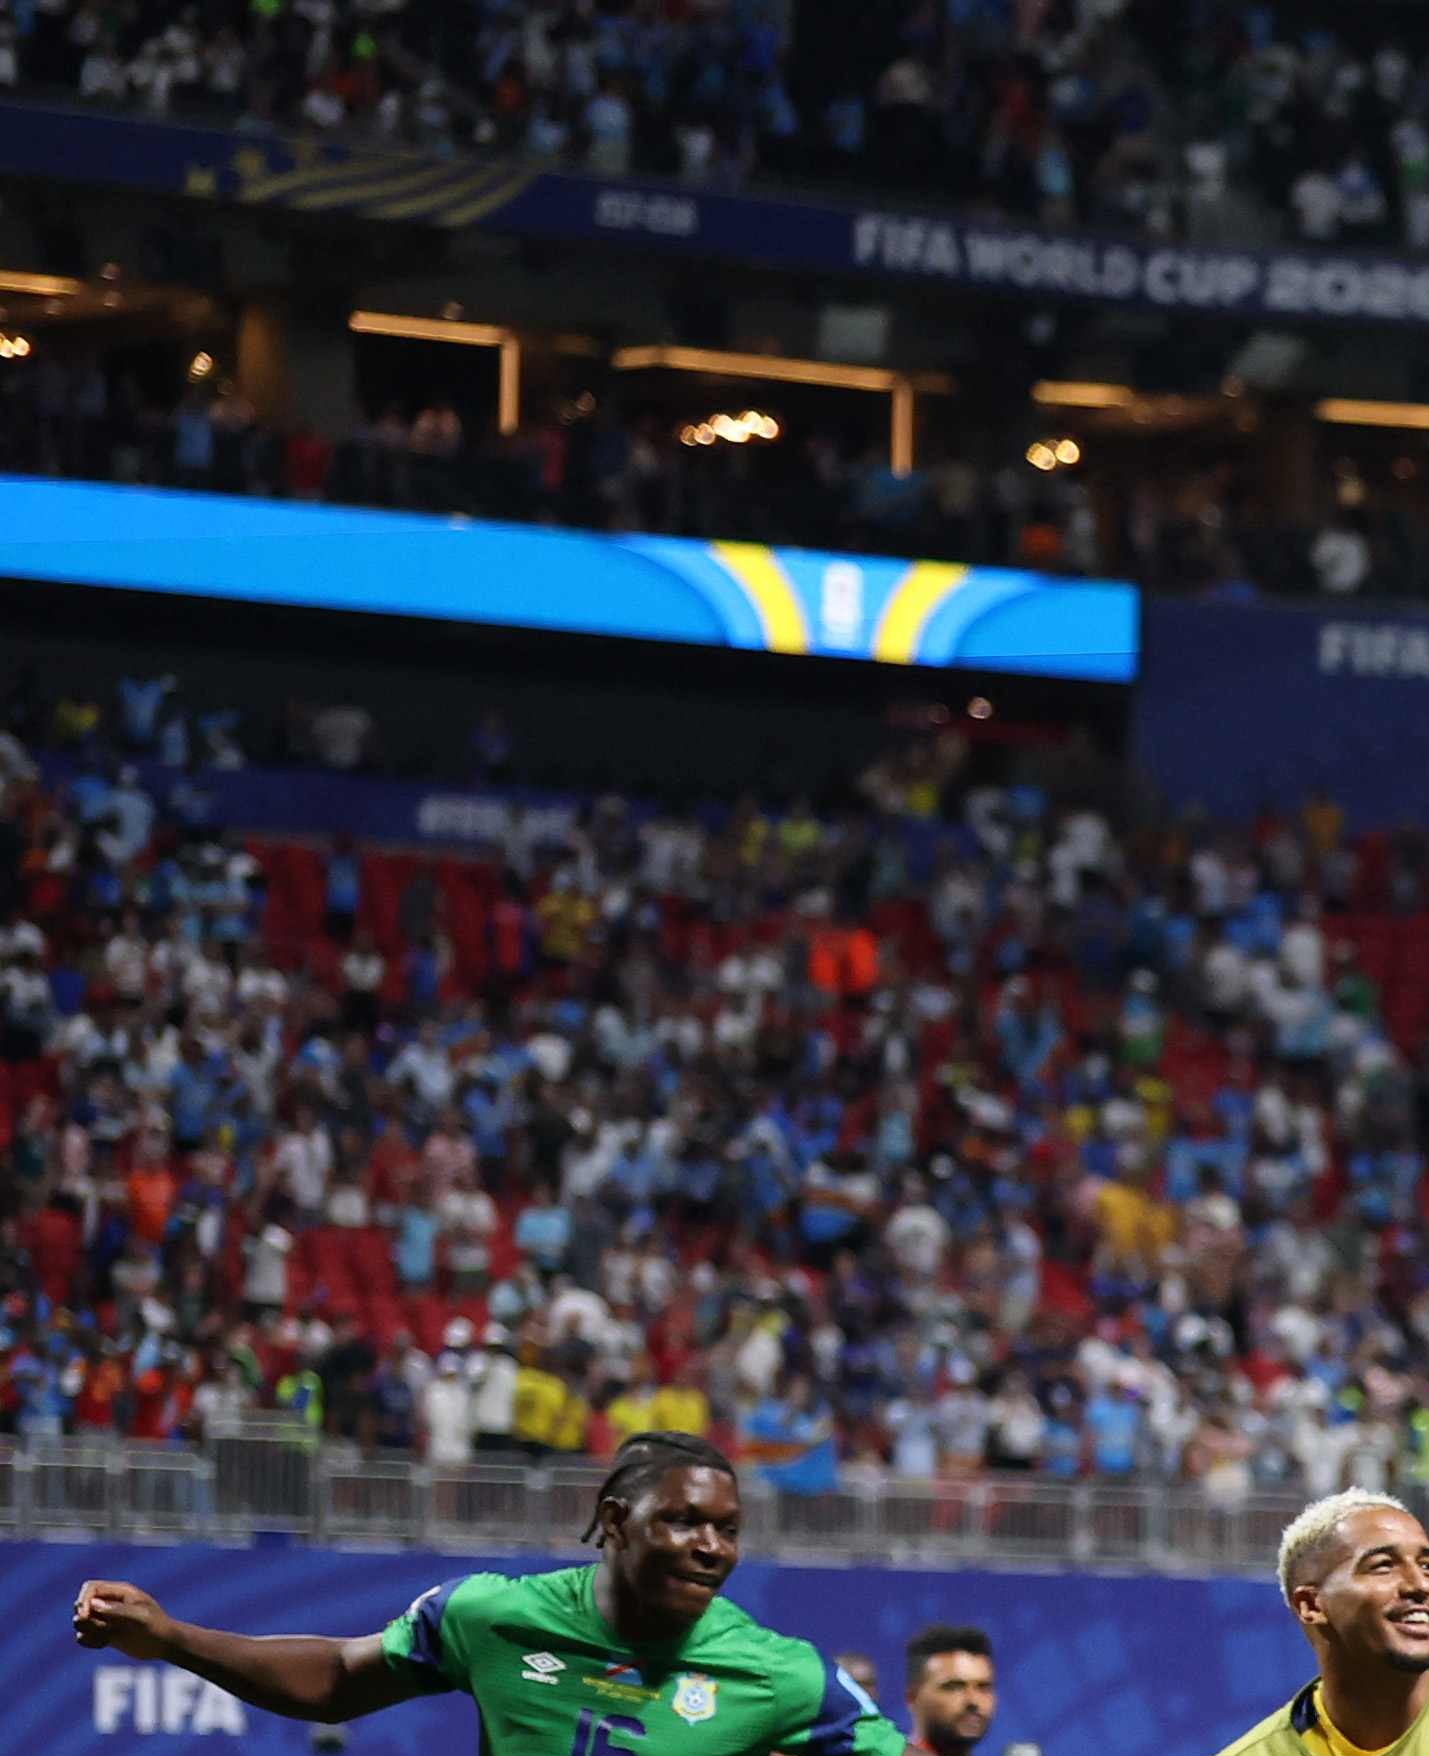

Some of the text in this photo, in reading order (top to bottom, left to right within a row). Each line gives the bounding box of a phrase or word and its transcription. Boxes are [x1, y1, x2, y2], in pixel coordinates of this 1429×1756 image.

[851, 211, 961, 278] FIFA
[964, 229, 1138, 299] WORLD
[1144, 246, 1259, 305] CUP
[94, 1664, 247, 1735] FIFA
